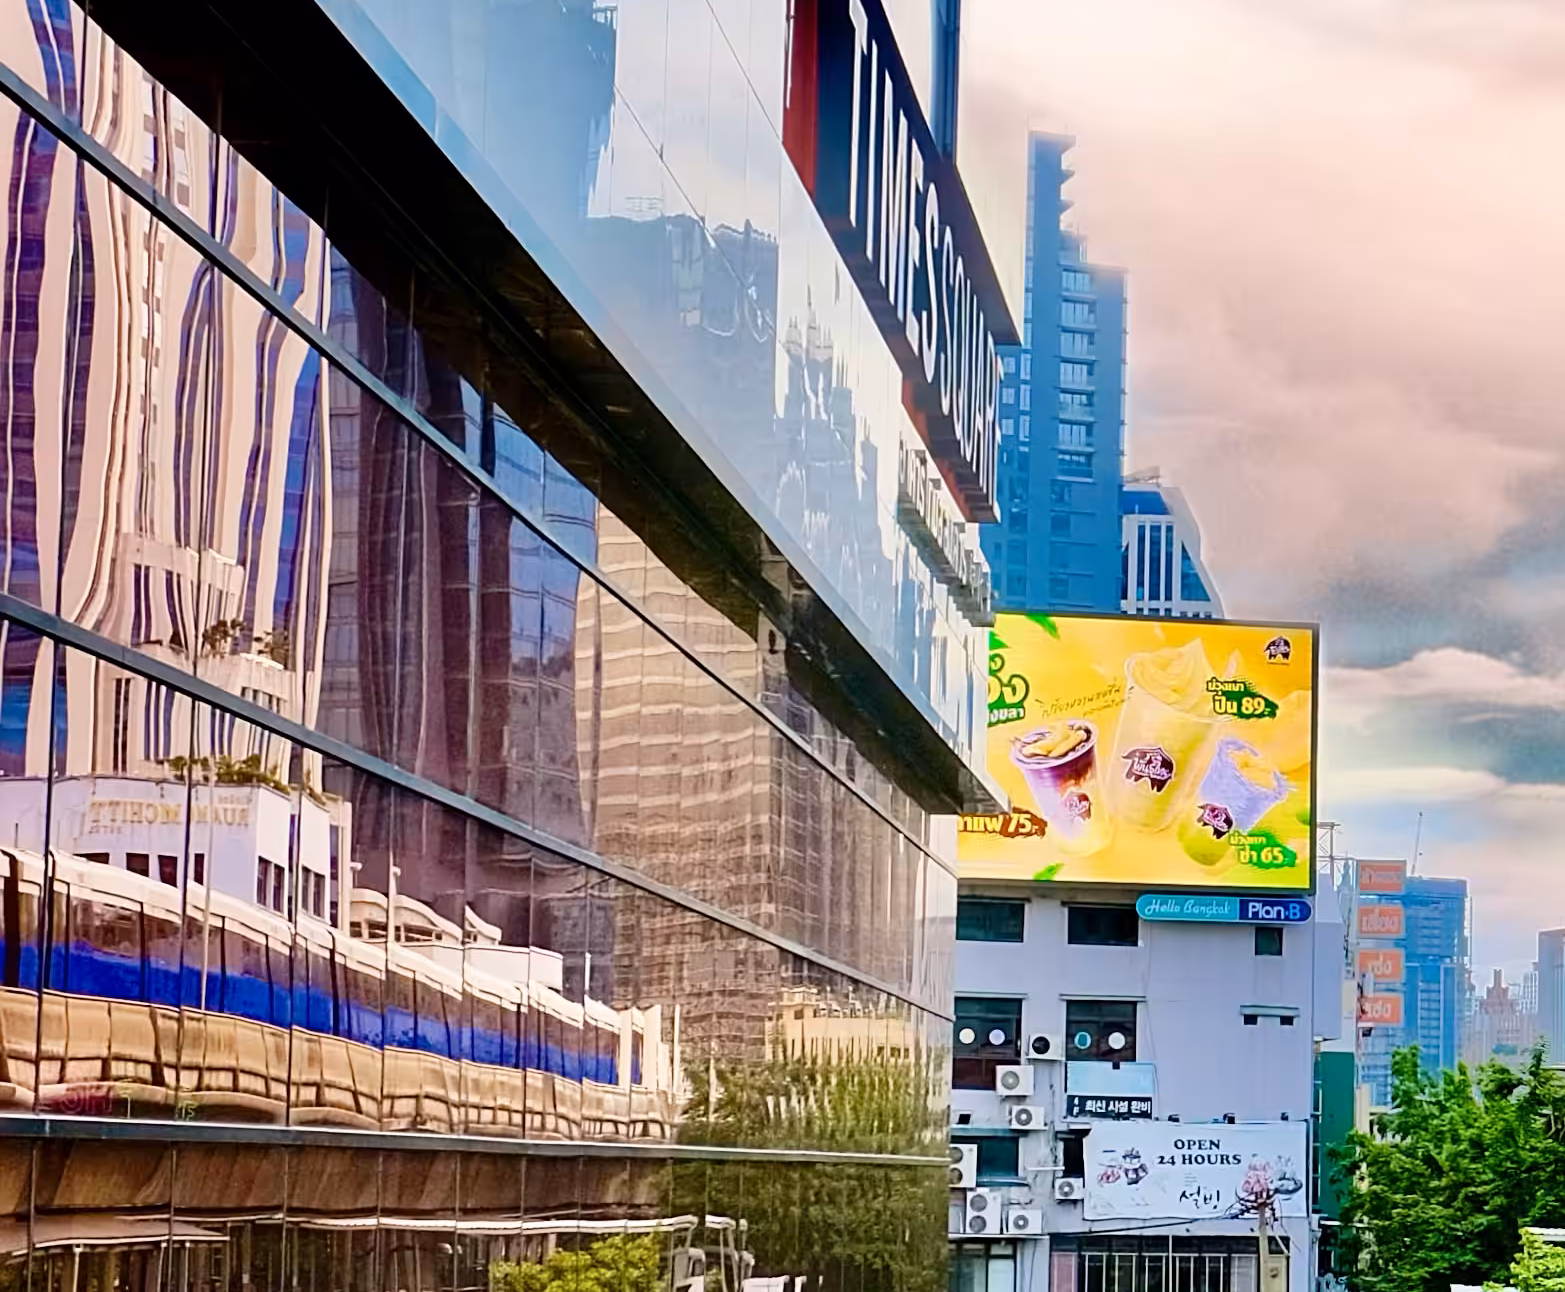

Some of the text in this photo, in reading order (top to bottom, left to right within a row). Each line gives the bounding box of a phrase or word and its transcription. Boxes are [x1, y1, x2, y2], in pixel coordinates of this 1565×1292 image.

[939, 225, 1004, 524] SQUARE
[1144, 898, 1232, 918] Hello Bangkok
[1084, 1099, 1106, 1113] 최신
[1107, 1100, 1129, 1114] 시설
[1173, 1138, 1222, 1151] OPEN
[1156, 1153, 1243, 1166] 24 HOURS
[1178, 1185, 1222, 1211] 설빙
